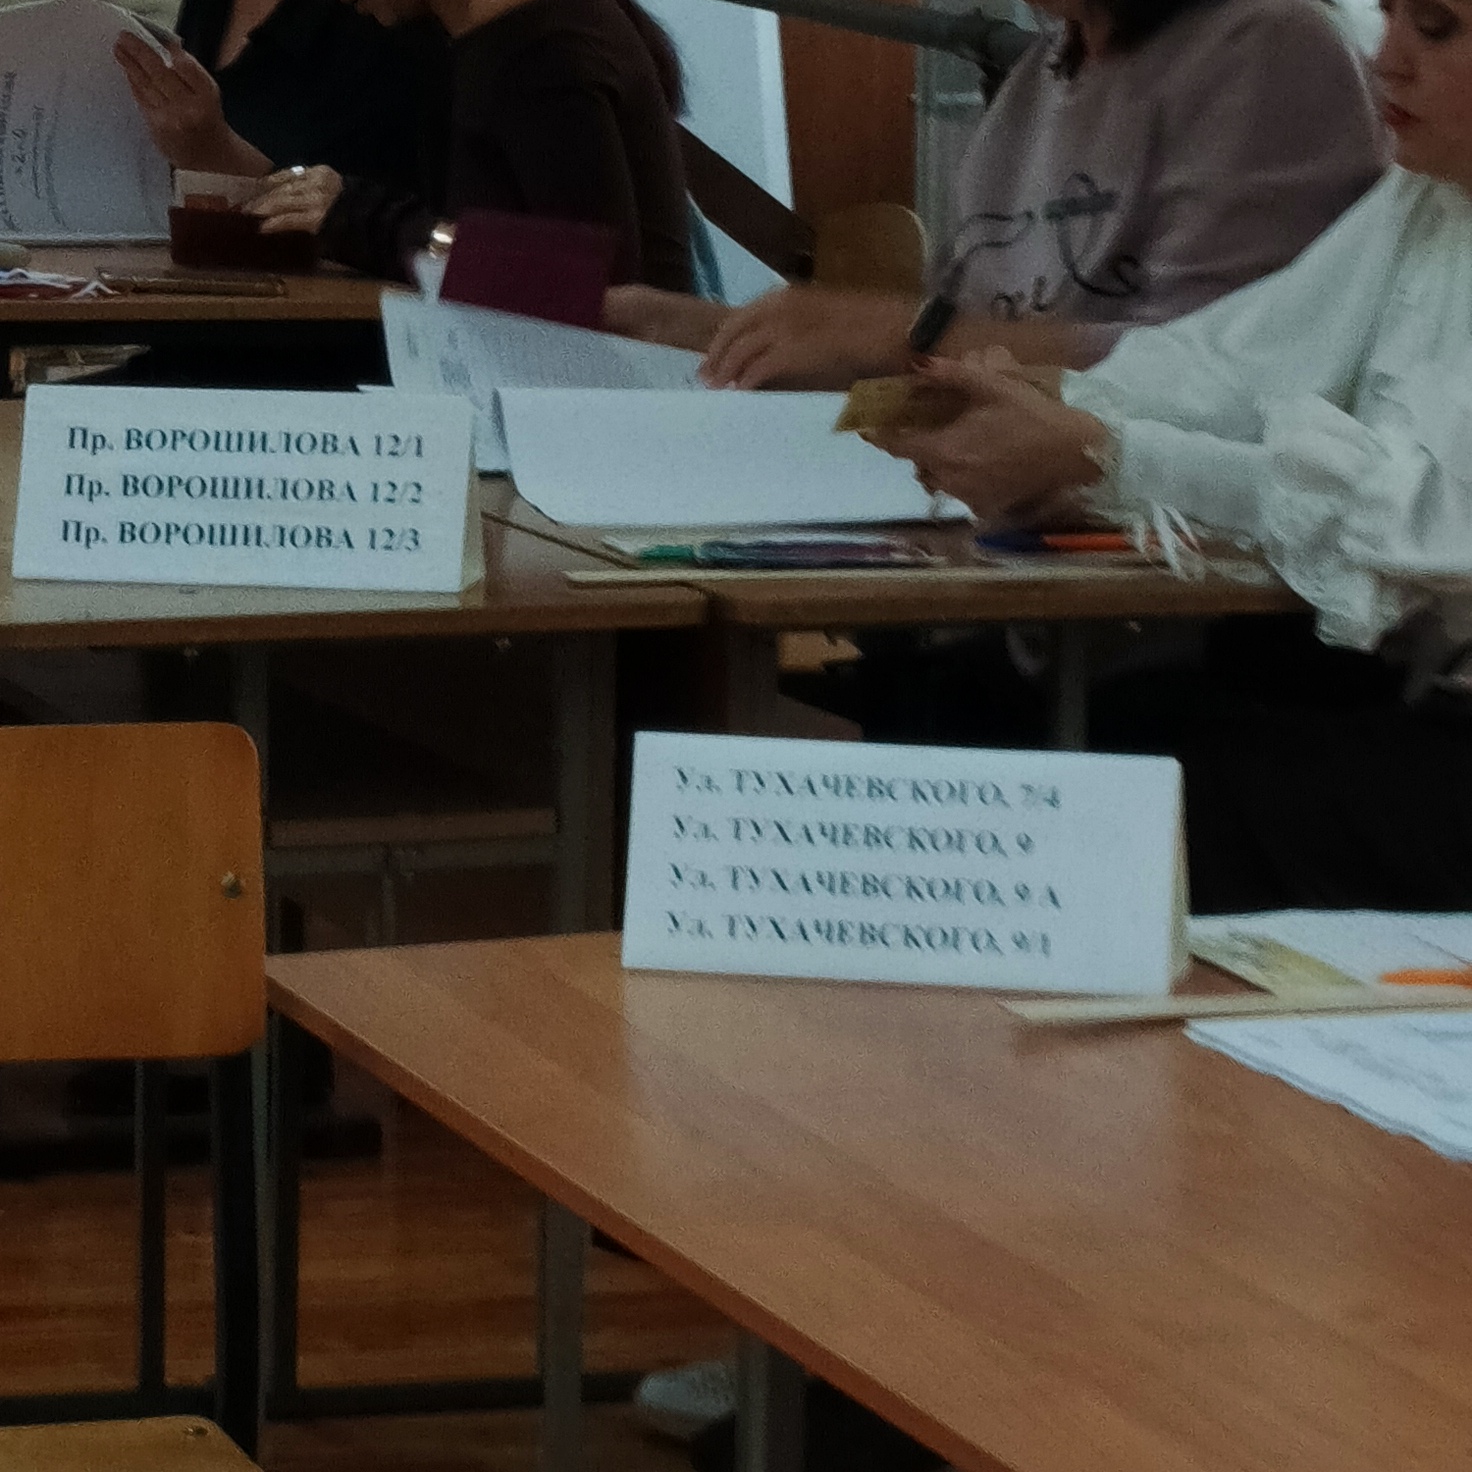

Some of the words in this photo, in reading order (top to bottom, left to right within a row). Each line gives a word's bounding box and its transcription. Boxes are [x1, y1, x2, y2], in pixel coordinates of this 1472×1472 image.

[67, 426, 116, 456] Пр.
[125, 428, 362, 457] ВОРОШИЛОВА
[374, 434, 425, 459] 12/1
[63, 474, 111, 504] Пр.
[122, 475, 358, 504] ВОРОШИЛОВА
[370, 480, 423, 505] 12/2
[60, 520, 108, 549] Пр.
[118, 522, 355, 552] ВОРОШИЛОВА
[367, 527, 421, 553] 12/3
